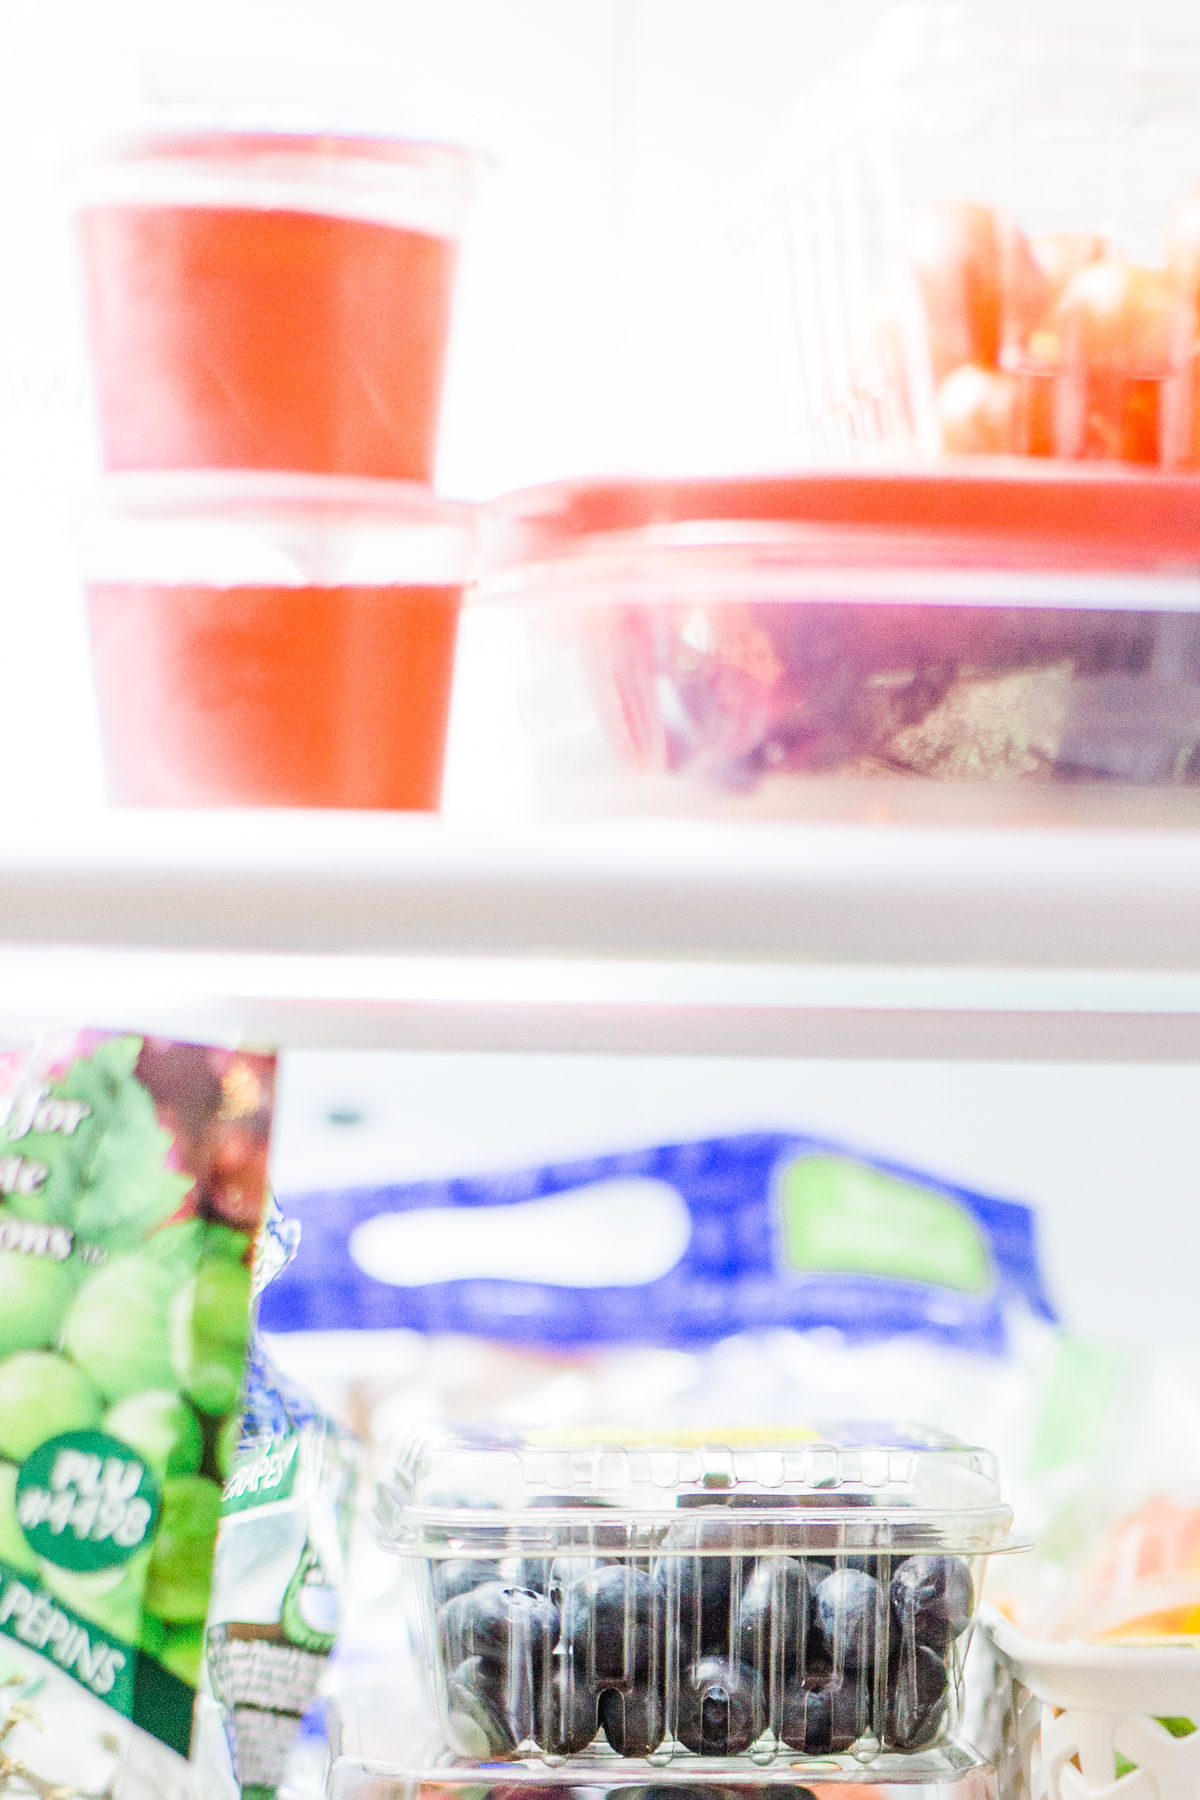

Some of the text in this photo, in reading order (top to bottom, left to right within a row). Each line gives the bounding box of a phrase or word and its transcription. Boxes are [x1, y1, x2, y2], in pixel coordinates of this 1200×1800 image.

[51, 1449, 144, 1503] PLU
[17, 1487, 152, 1547] #4498
[0, 1580, 126, 1694] PEPINS
